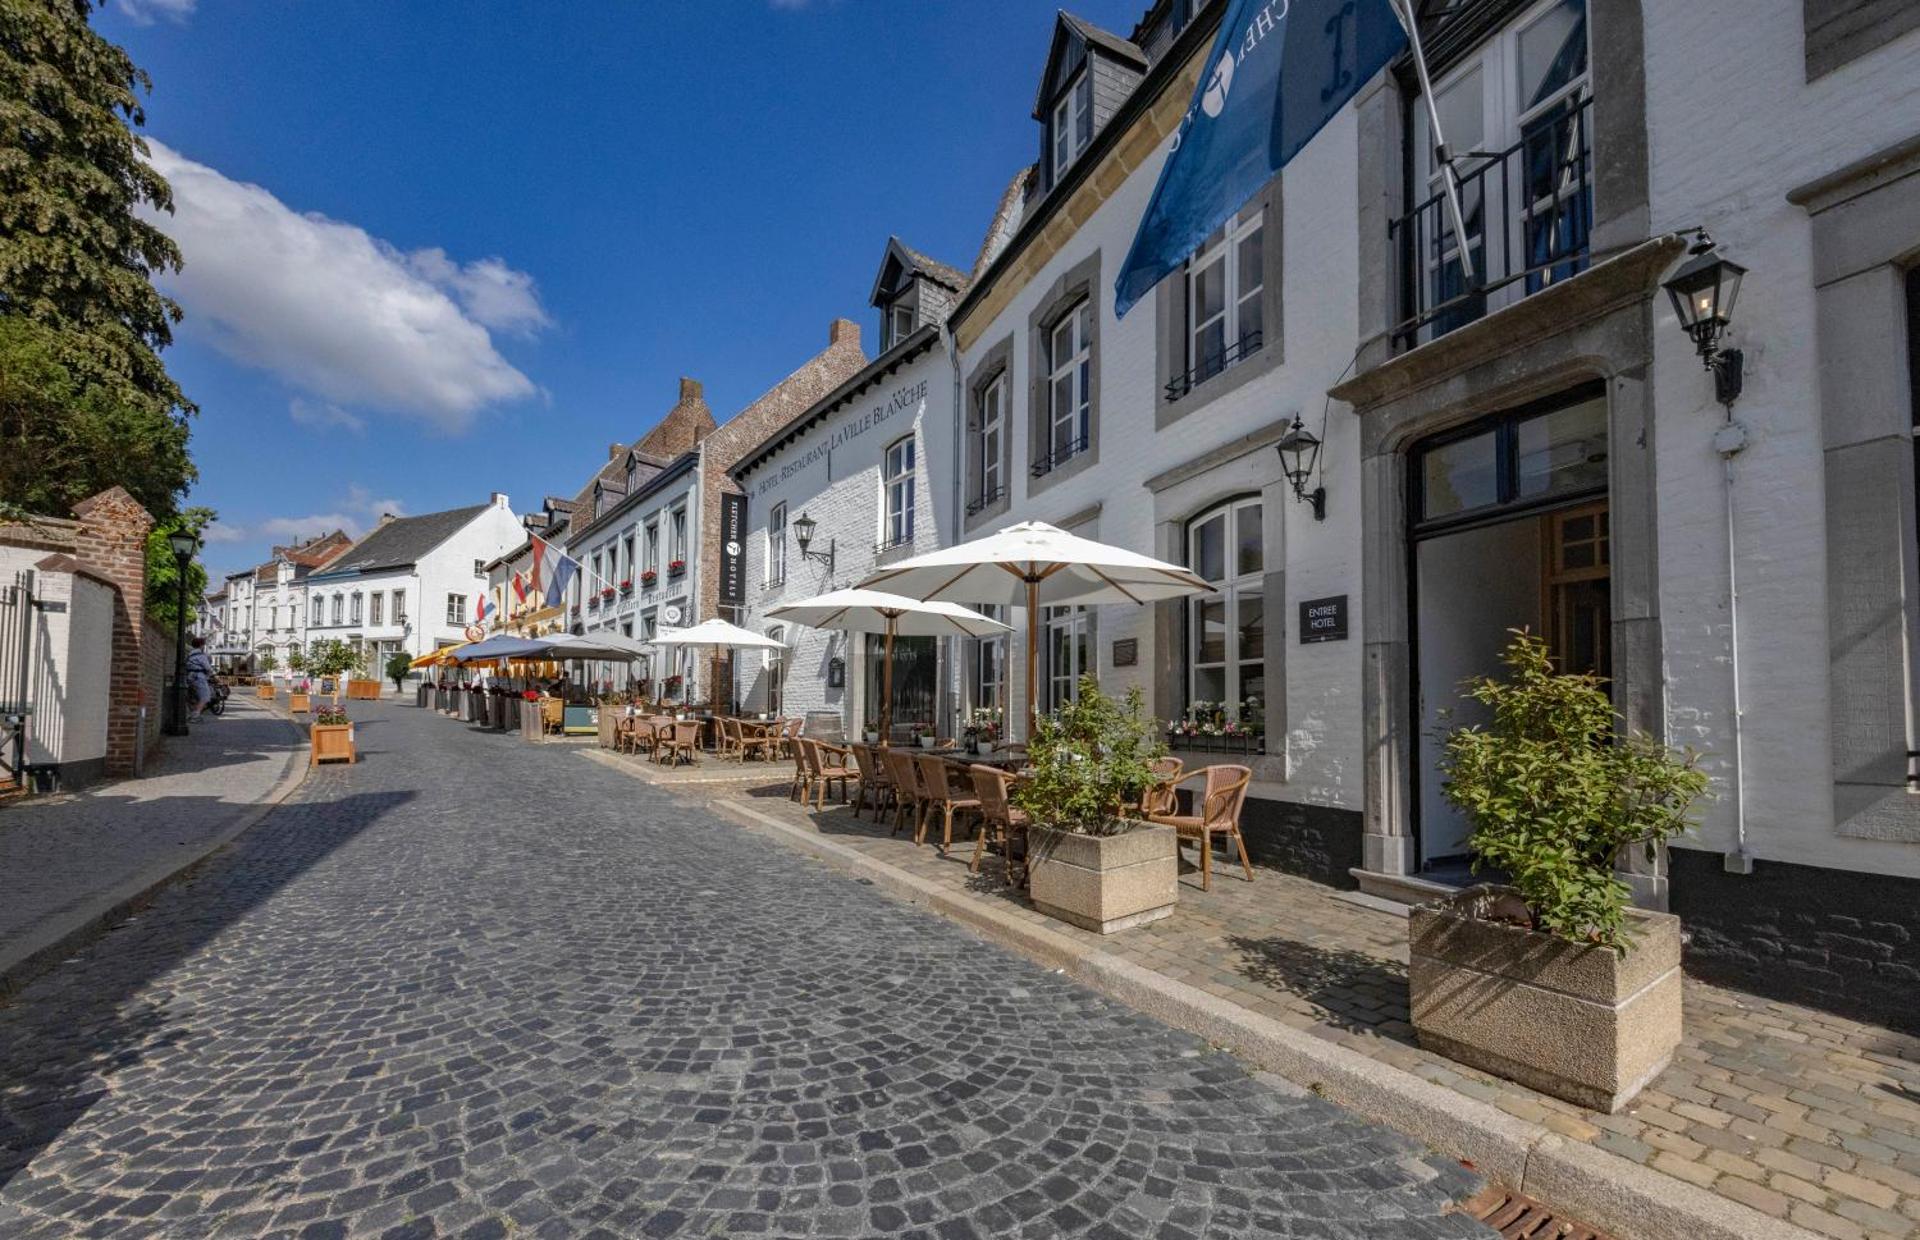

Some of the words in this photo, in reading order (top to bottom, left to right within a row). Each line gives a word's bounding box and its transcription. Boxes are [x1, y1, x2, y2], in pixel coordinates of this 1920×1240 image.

[843, 414, 871, 441] VILLE
[873, 379, 928, 426] BLANCHE
[730, 502, 738, 540] FLETCHER
[729, 558, 737, 596] HOTELS
[1309, 605, 1336, 618] ENTREE
[1311, 617, 1336, 629] HOTEL
